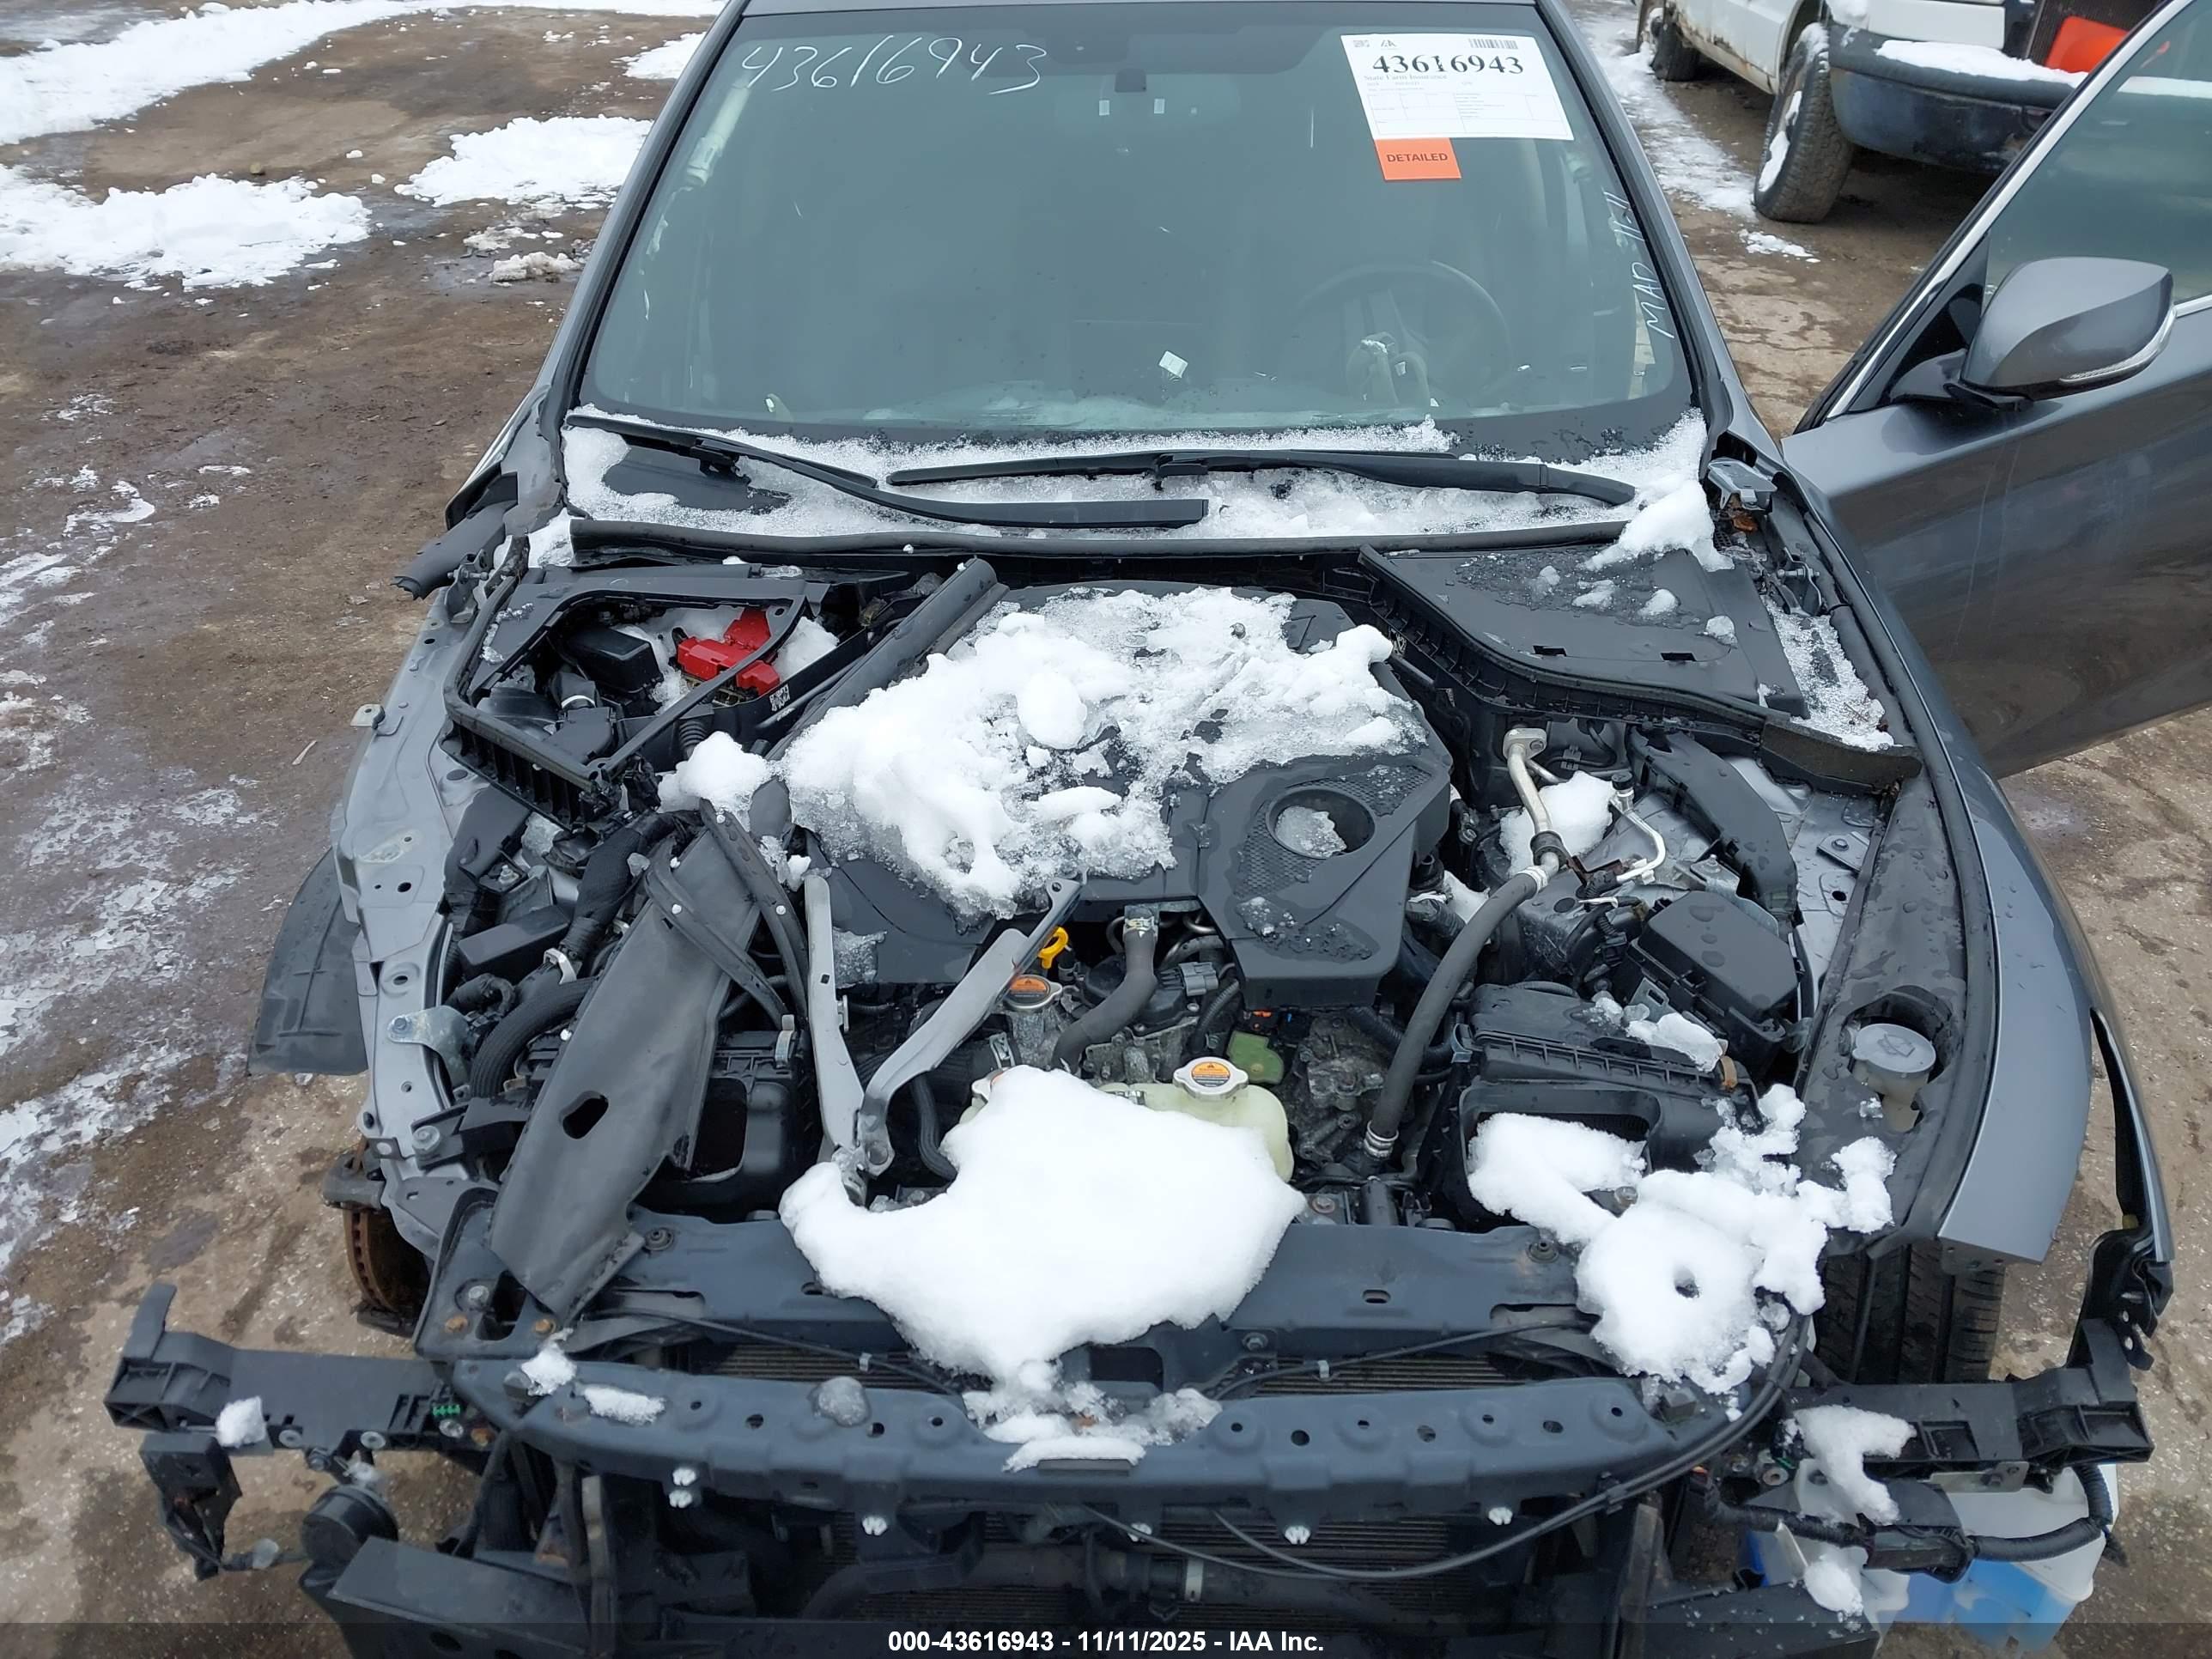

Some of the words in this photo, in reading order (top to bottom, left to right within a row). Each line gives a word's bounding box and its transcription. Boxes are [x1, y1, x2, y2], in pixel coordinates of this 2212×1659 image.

[741, 34, 1048, 95] 43616943
[1372, 54, 1524, 75] 43616943
[1386, 152, 1449, 163] DETAILED
